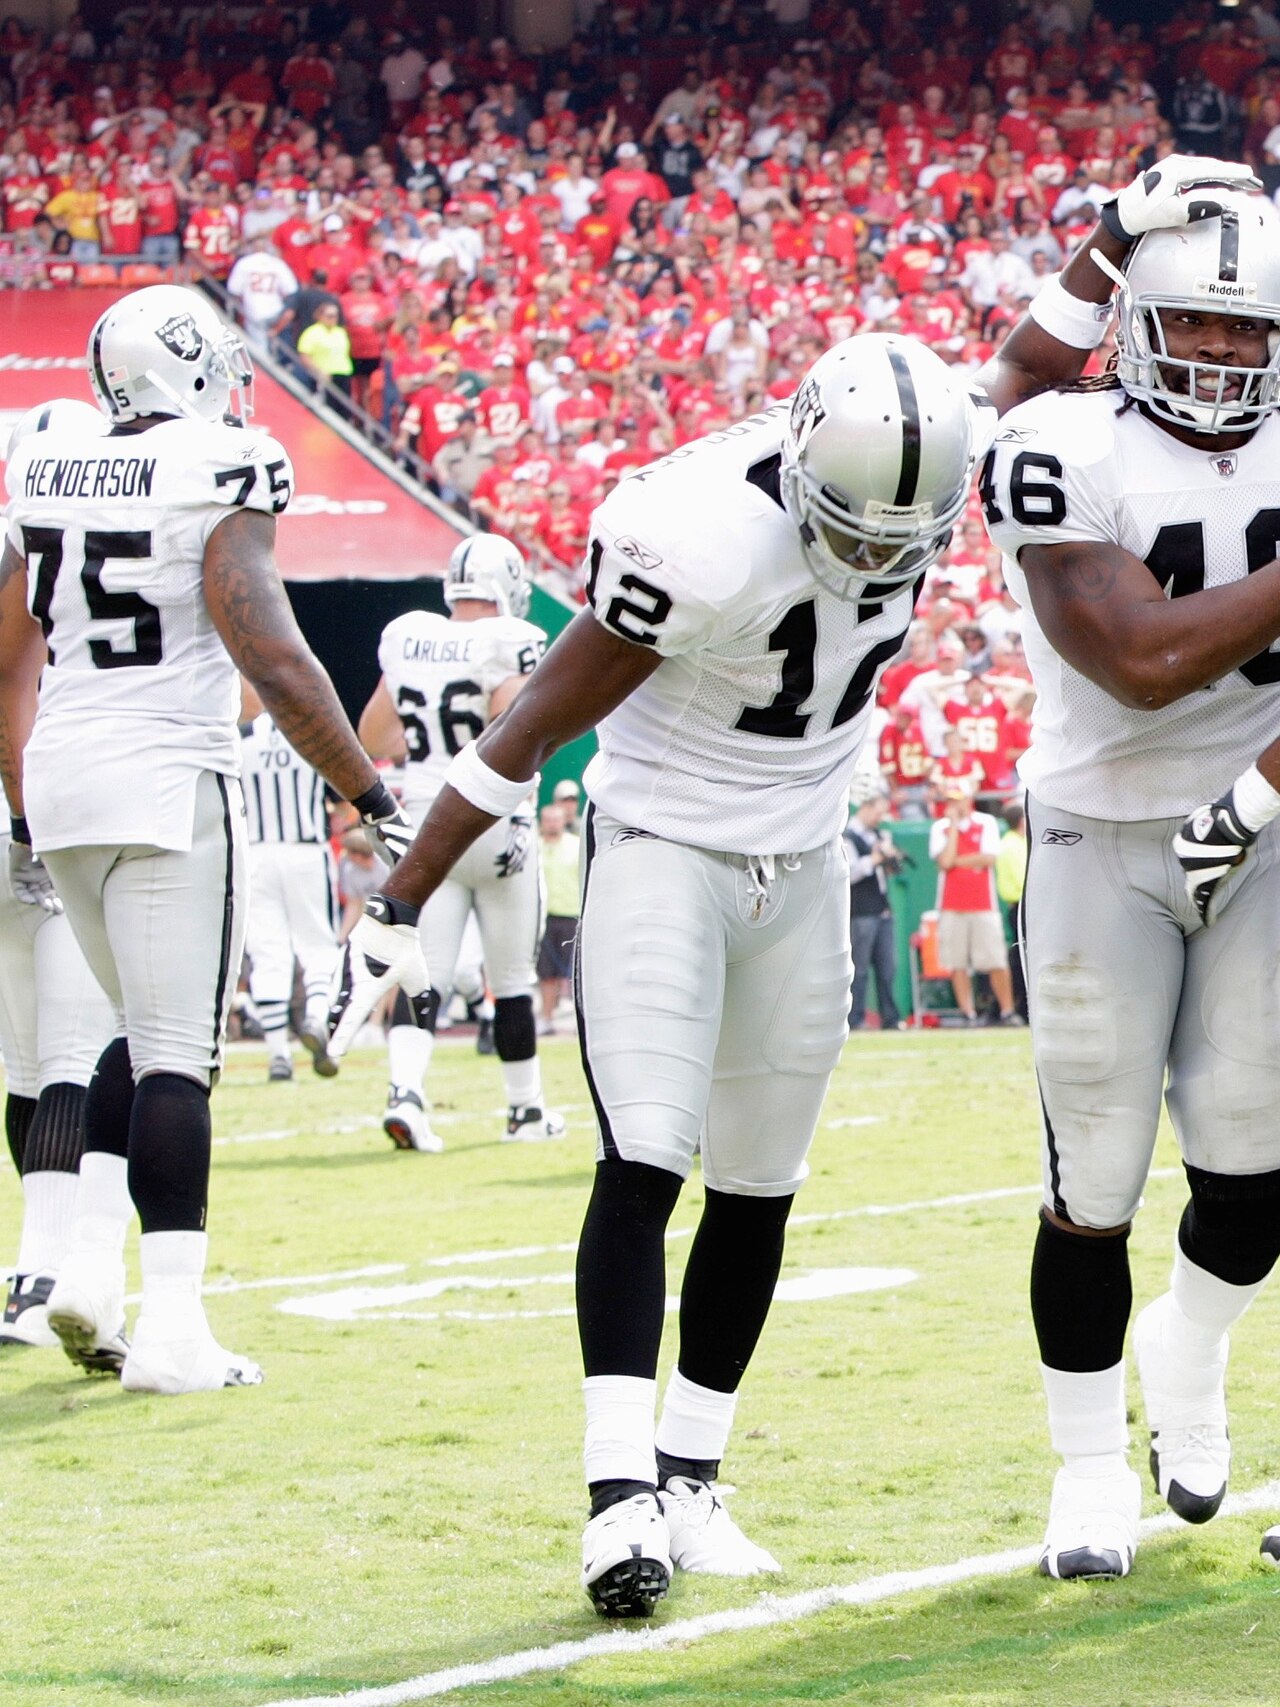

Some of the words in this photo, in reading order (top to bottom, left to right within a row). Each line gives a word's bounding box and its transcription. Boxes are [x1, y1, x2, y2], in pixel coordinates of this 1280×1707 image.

[1208, 284, 1244, 297] Riddell
[25, 458, 157, 498] HENDERSON
[214, 459, 291, 513] 75
[21, 525, 164, 669] 75
[402, 637, 474, 663] CARLISLE
[259, 748, 291, 769] 70
